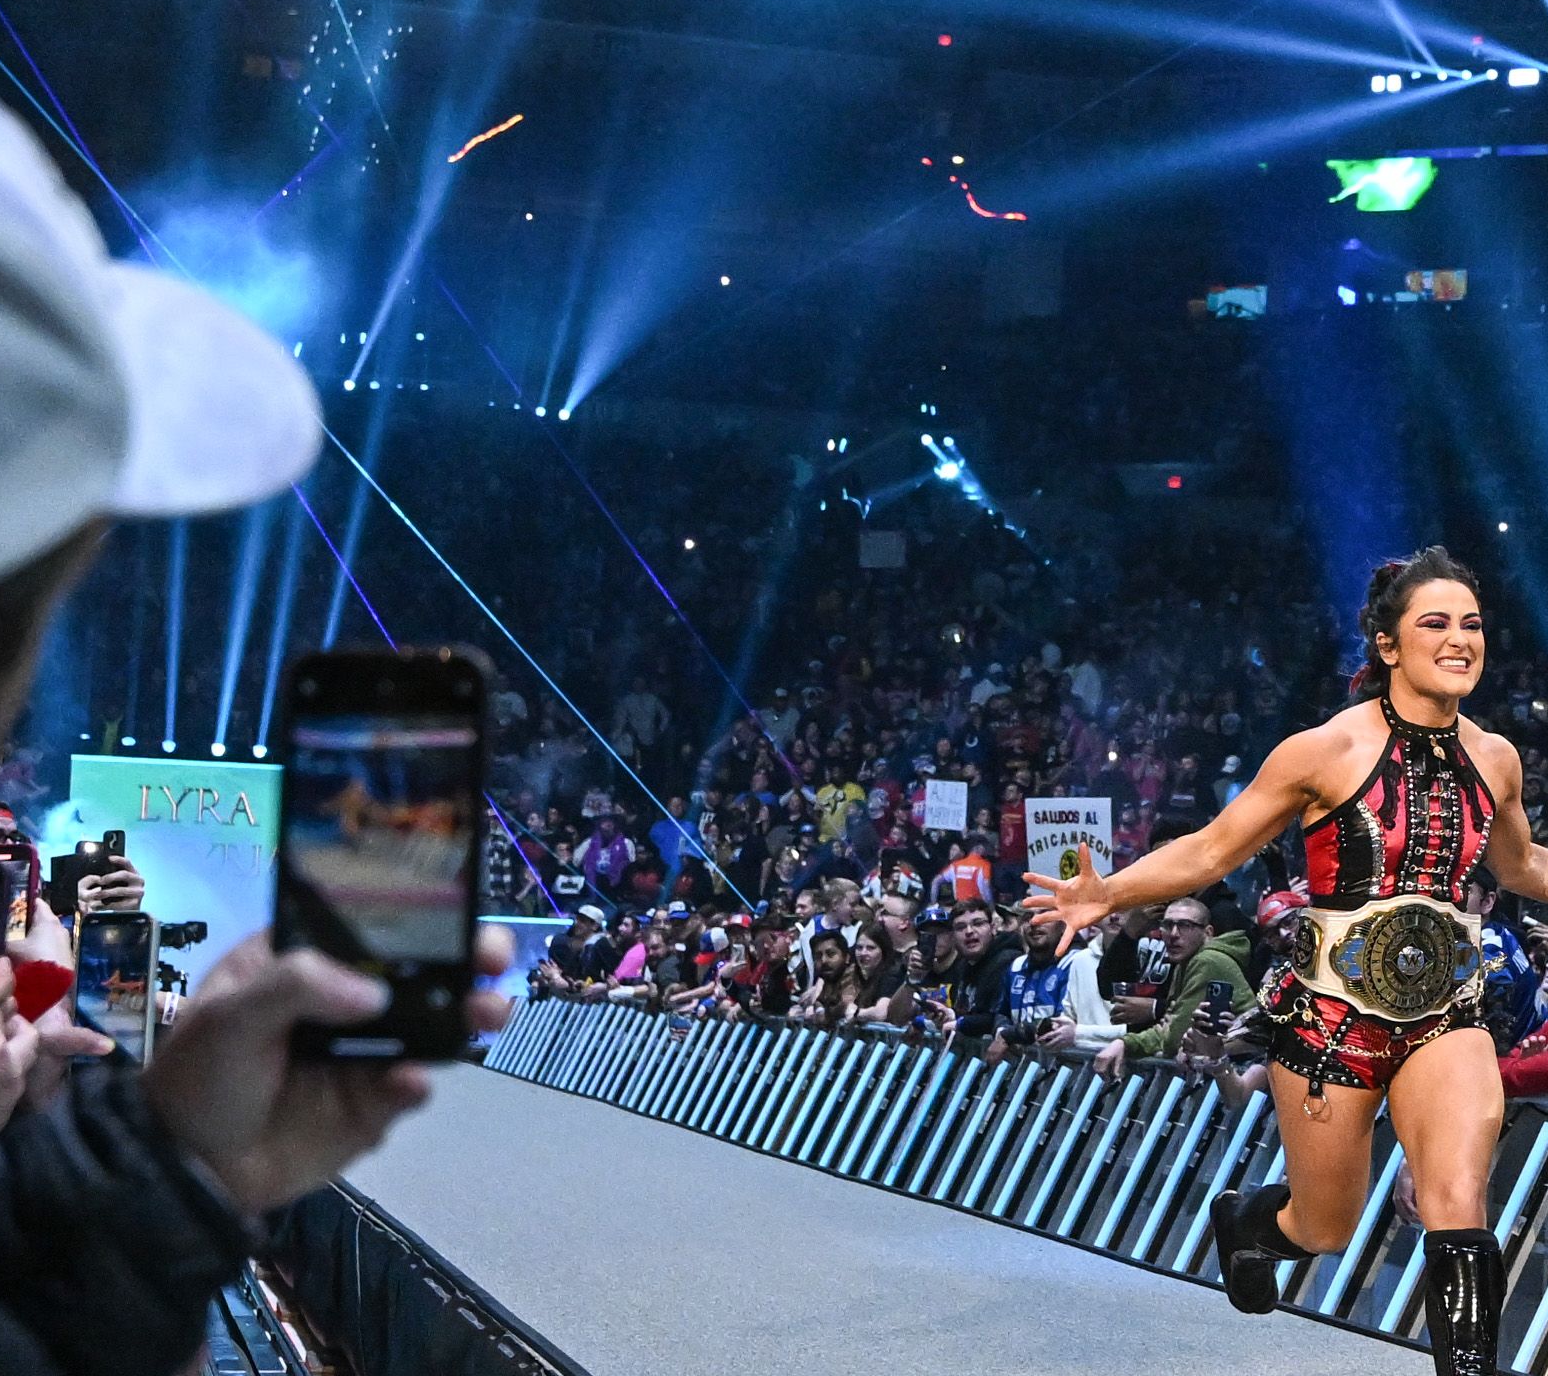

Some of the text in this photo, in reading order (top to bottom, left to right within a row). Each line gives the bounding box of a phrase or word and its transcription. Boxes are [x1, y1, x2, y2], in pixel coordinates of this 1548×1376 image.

[139, 784, 260, 827] LYRA
[1034, 810, 1100, 826] SALUDOS AL
